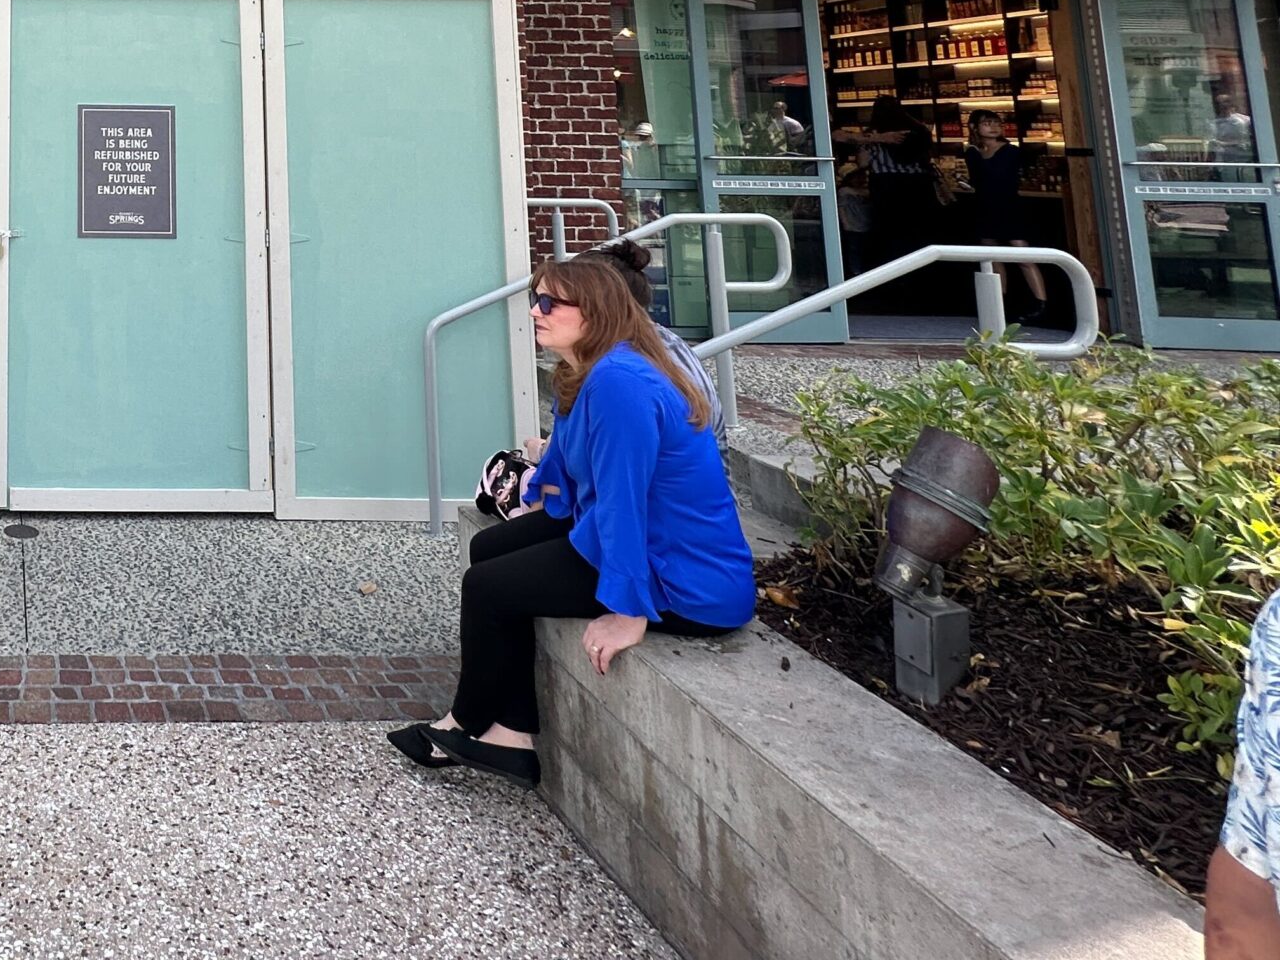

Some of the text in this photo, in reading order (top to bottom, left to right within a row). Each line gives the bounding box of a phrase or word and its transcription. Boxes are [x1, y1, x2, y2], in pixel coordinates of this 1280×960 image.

[101, 127, 153, 138] THIS AREA
[106, 139, 148, 149] IS BEING
[94, 151, 160, 161] REFURBISHED
[102, 162, 152, 172] FOR YOUR
[108, 174, 146, 184] FUTURE
[97, 185, 157, 196] ENJOYMENT
[109, 214, 145, 225] SPRINGS
